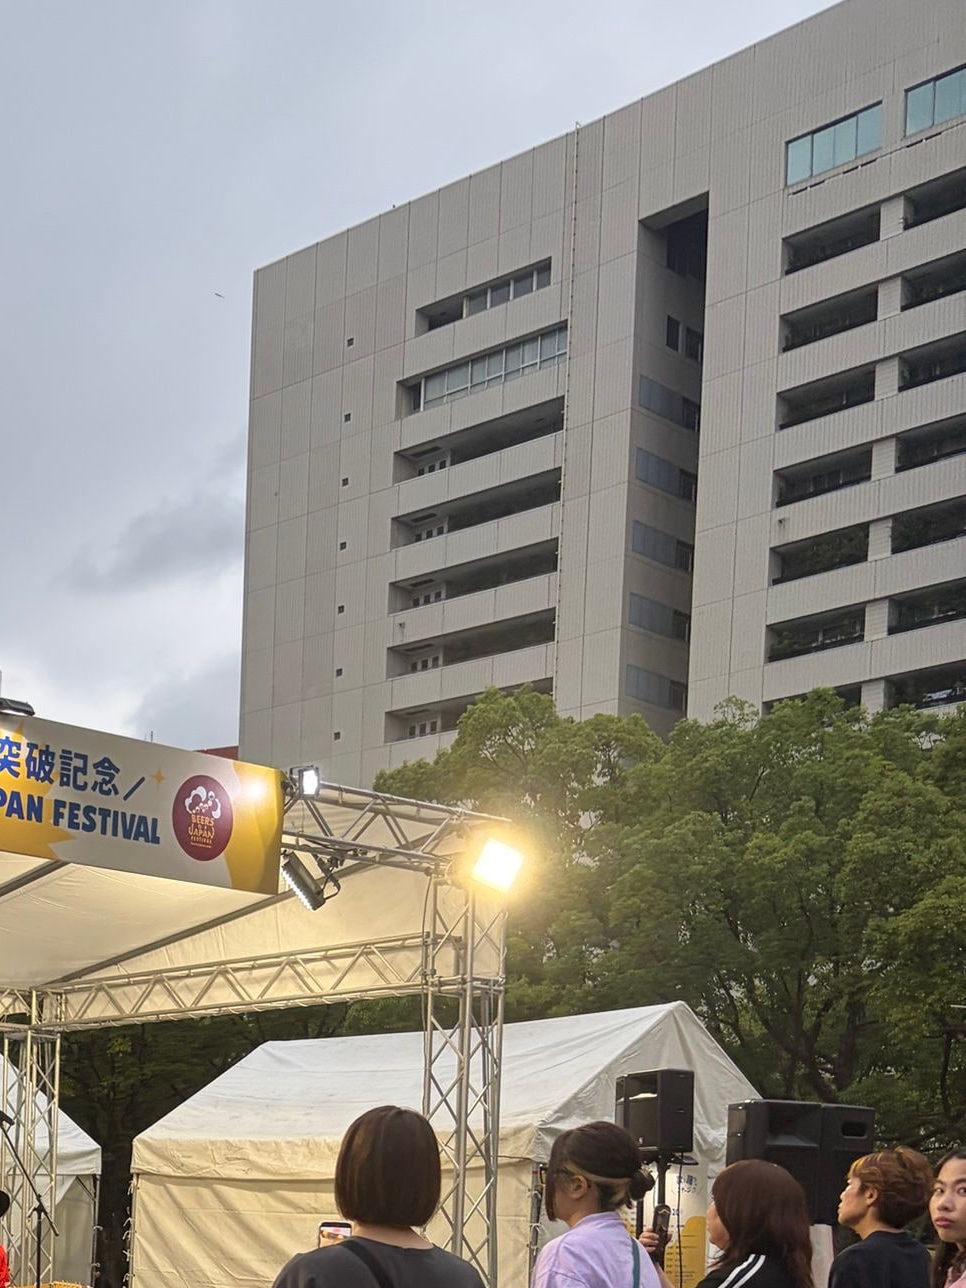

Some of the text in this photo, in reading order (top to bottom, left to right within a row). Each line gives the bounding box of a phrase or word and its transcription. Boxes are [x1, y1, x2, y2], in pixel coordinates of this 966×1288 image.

[52, 798, 161, 845] FESTIVAL
[190, 814, 215, 827] BEERS
[188, 823, 215, 840] JAPAN
